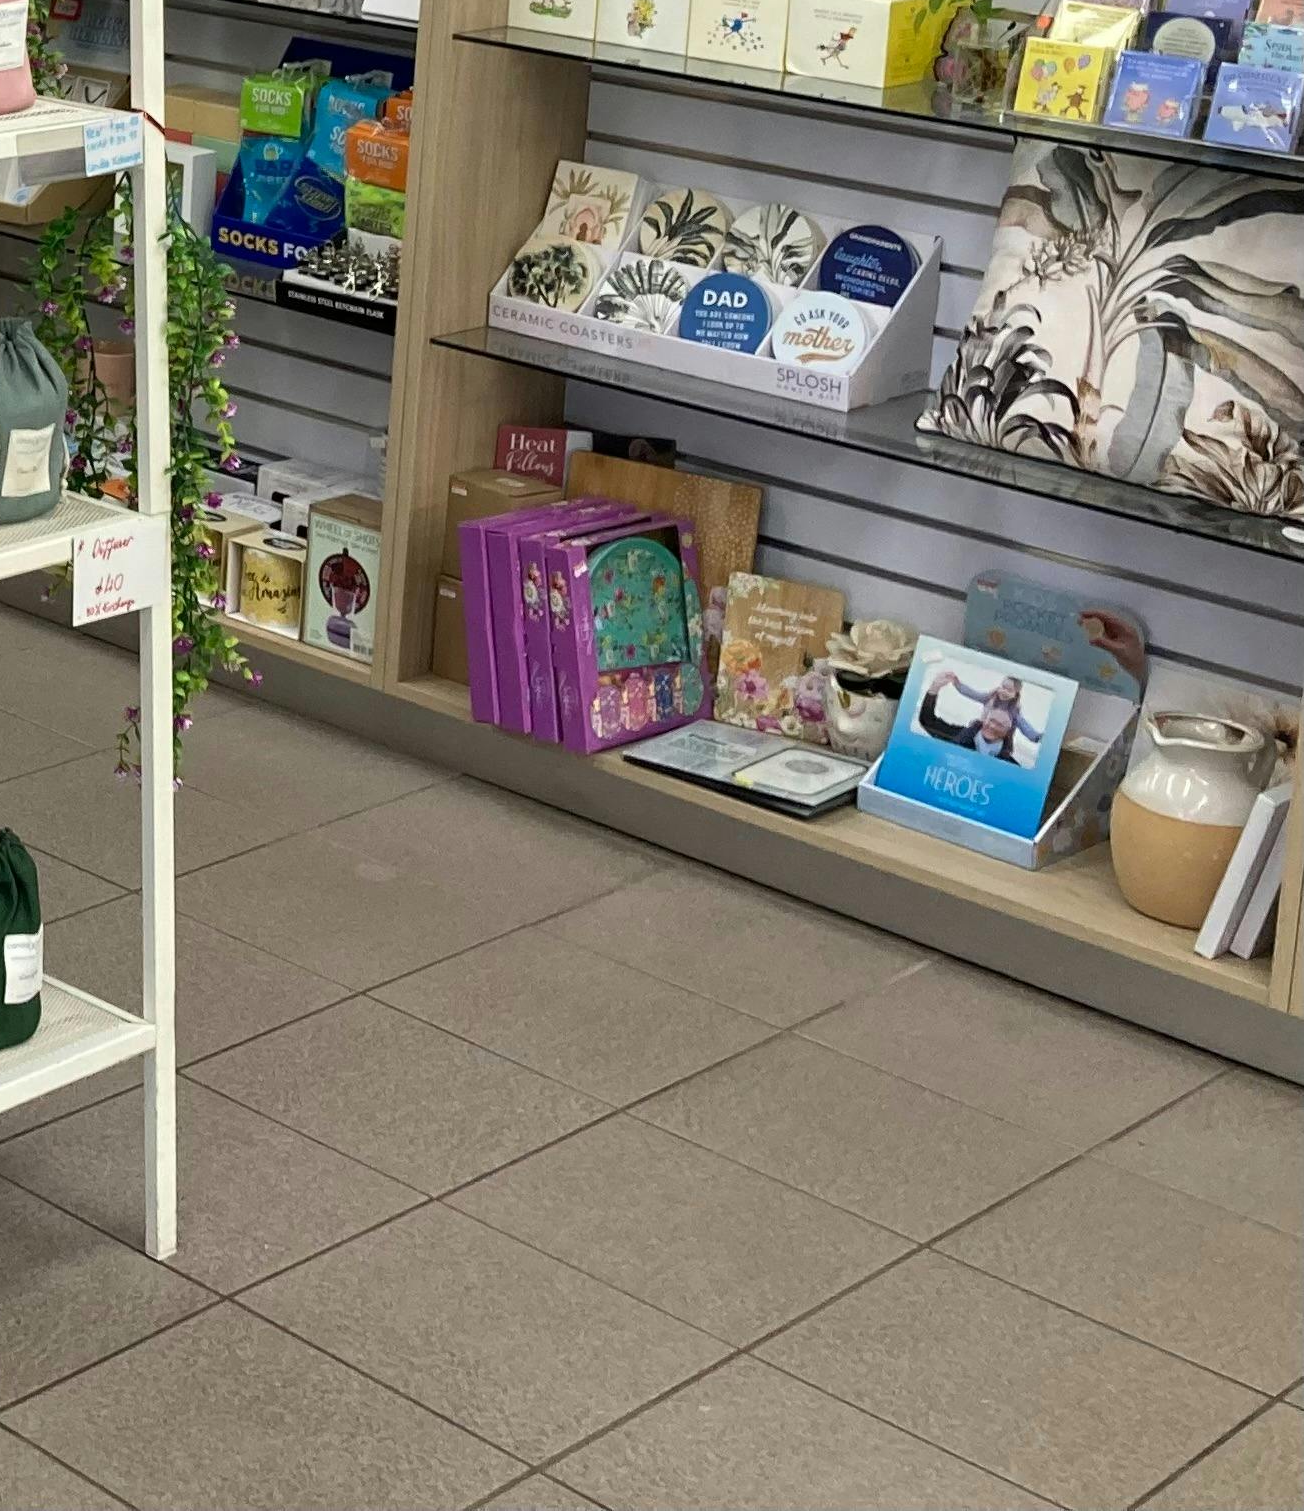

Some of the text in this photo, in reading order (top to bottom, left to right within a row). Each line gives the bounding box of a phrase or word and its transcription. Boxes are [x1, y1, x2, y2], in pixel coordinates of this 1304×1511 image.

[252, 88, 292, 105] SOCKS
[357, 139, 398, 161] SOCKS
[218, 227, 279, 256] SOCKS
[317, 297, 333, 307] STEEL
[703, 290, 748, 308] DAD
[494, 304, 633, 351] CERAMIC COASTERS
[794, 309, 850, 329] GO ASK YOUR
[783, 326, 855, 351] mother
[777, 367, 841, 394] SPLOSH
[510, 433, 556, 454] Heat
[923, 765, 994, 805] HEROES
